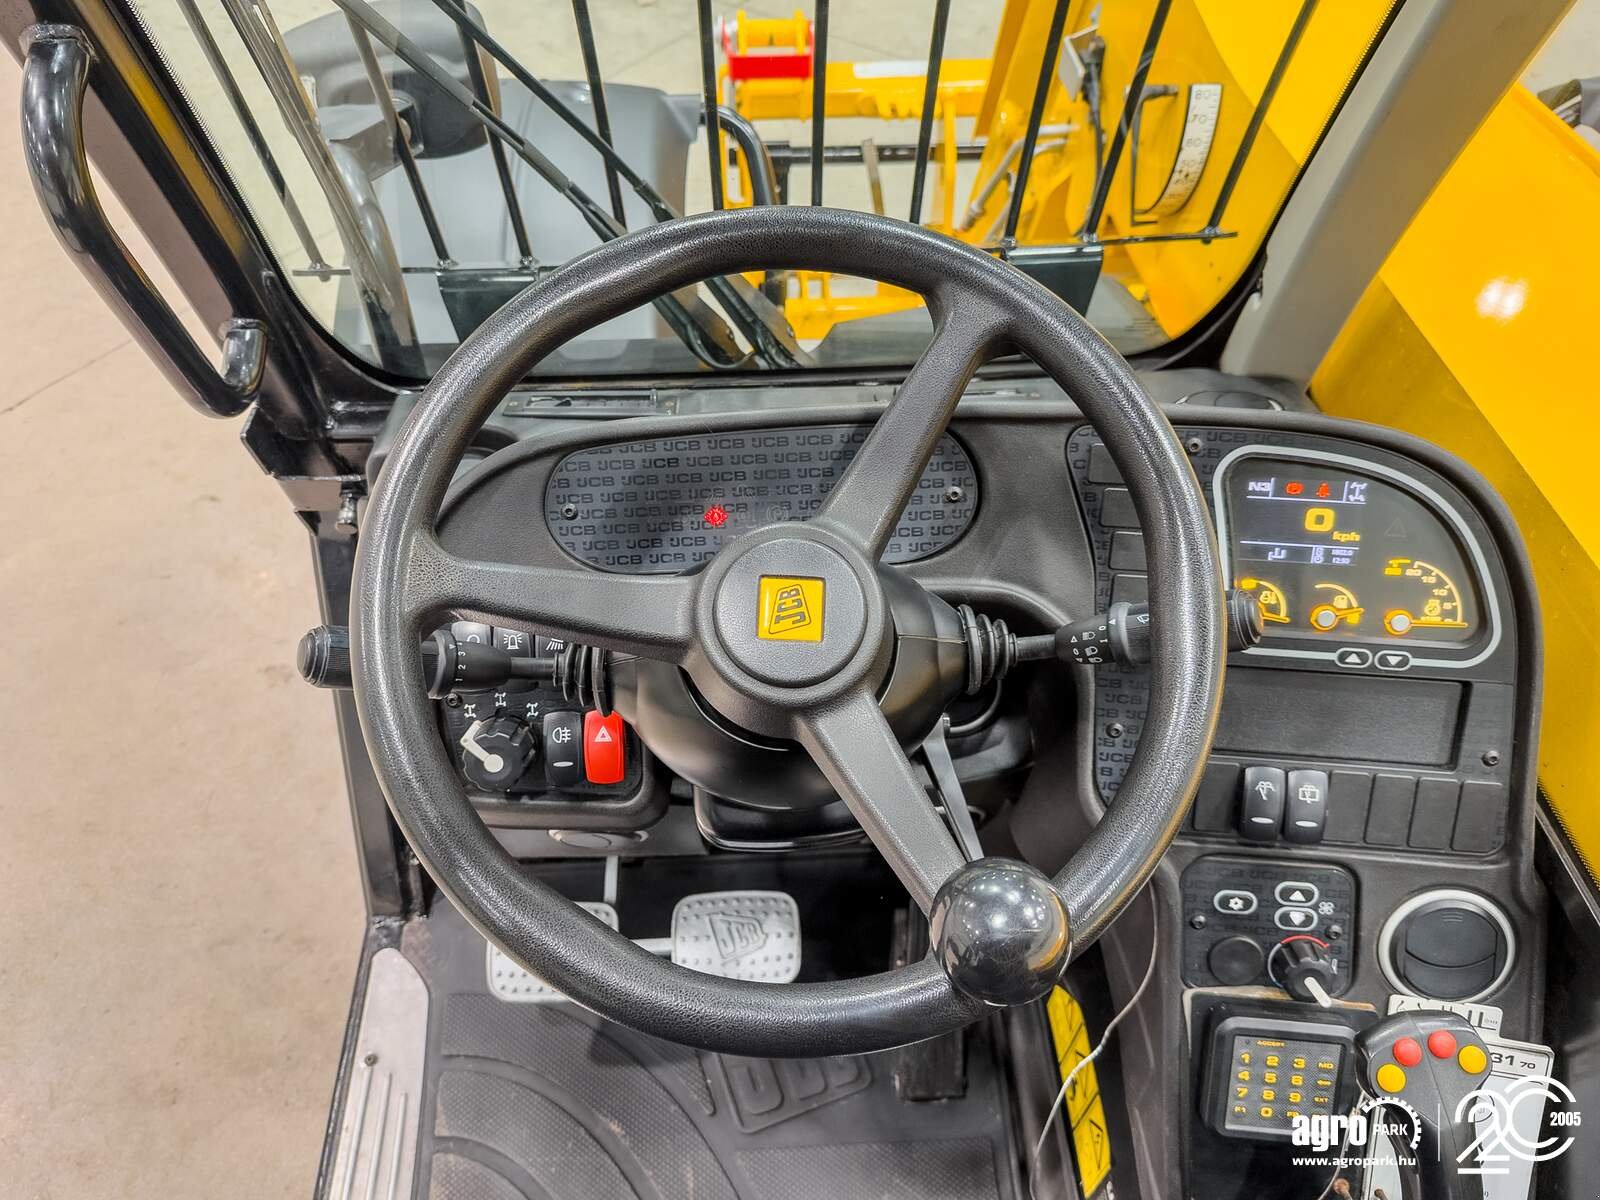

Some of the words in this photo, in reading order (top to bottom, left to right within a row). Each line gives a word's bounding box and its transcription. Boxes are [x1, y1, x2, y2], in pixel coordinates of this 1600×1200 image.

[664, 440, 700, 451] JCB
[708, 438, 745, 450] JCB
[752, 435, 788, 448] JCB
[796, 434, 834, 446] JCB
[600, 460, 636, 470] JCB
[643, 458, 679, 469] JCB
[687, 456, 723, 467] JCB
[731, 454, 768, 465] JCB
[774, 452, 812, 464] JCB
[929, 461, 967, 472] JCB
[577, 476, 614, 488] JCB
[622, 475, 658, 486] JCB
[665, 473, 702, 484] JCB
[710, 471, 746, 482] JCB
[754, 469, 790, 480] JCB
[798, 467, 834, 478] JCB
[556, 494, 593, 504] JCB
[600, 492, 636, 502] JCB
[645, 490, 680, 501] JCB
[776, 484, 812, 495] JCB
[580, 508, 617, 520] JCB
[624, 506, 661, 518] JCB
[908, 510, 945, 521] JCB
[1304, 507, 1335, 532] 0
[559, 526, 596, 536] JCB
[603, 524, 640, 534] JCB
[648, 522, 684, 532] JCB
[582, 540, 620, 551] JCB
[626, 538, 663, 549] JCB
[670, 537, 706, 548] JCB
[1332, 532, 1360, 542] kph
[606, 554, 642, 566] JCB
[650, 552, 686, 564] JCB
[774, 588, 806, 625] JCB
[1104, 694, 1142, 704] JCB
[1241, 1053, 1250, 1064] 1
[1266, 1056, 1279, 1067] 2
[1293, 1058, 1306, 1069] 3
[1520, 1061, 1536, 1070] 70
[1238, 1071, 1250, 1081] 4
[1264, 1073, 1277, 1084] 5
[1291, 1075, 1304, 1086] 6
[1237, 1088, 1248, 1098] 7
[1262, 1090, 1275, 1101] 8
[1289, 1092, 1302, 1103] 9
[1260, 1106, 1273, 1118] 0
